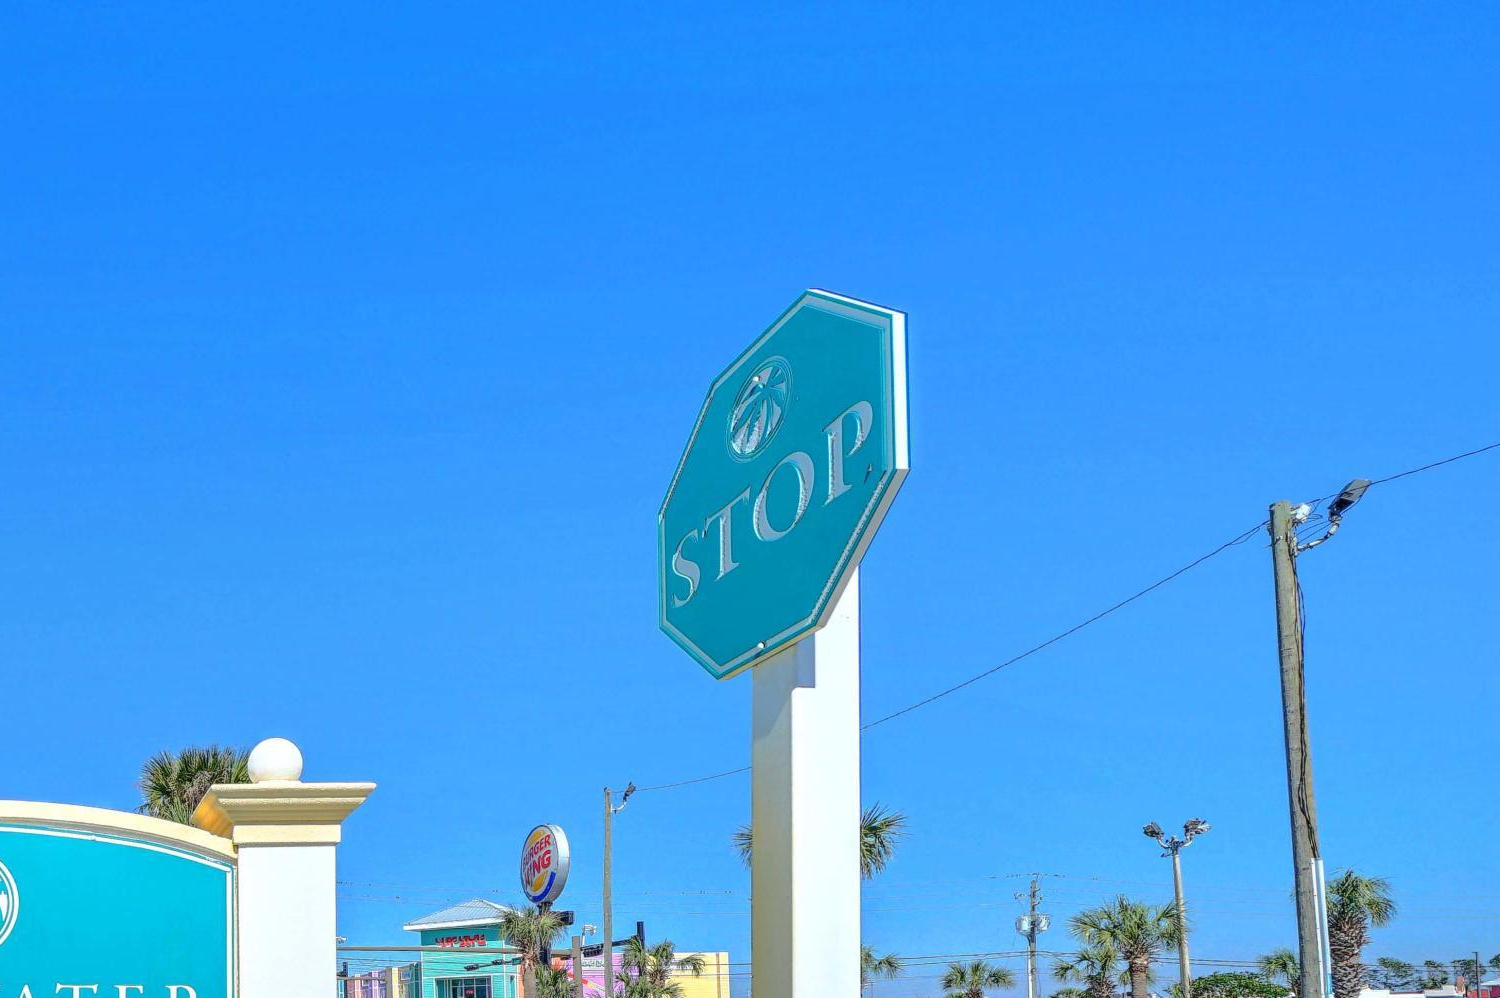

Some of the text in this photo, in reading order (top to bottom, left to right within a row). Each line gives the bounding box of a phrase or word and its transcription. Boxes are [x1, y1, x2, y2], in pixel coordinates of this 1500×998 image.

[671, 400, 874, 608] STOP
[523, 834, 551, 873] BURGER
[525, 849, 552, 890] KING
